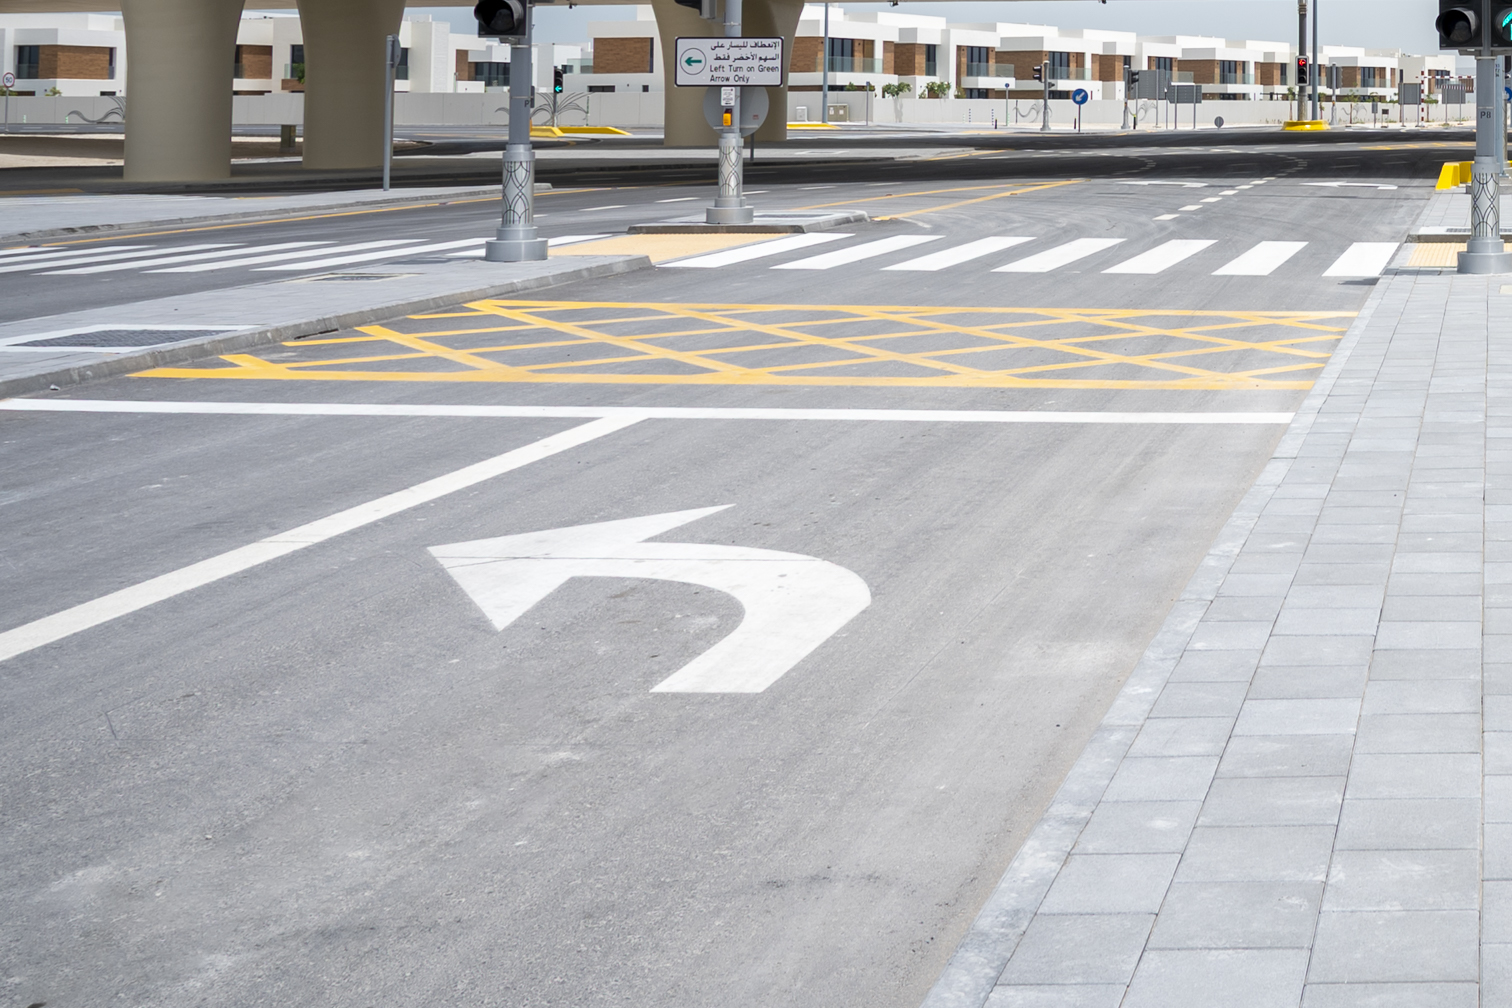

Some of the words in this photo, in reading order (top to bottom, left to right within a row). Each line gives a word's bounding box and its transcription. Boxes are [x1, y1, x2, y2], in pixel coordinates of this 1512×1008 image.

[710, 41, 725, 51] على
[726, 41, 748, 50] لليسار
[713, 53, 730, 61] فقط
[732, 52, 758, 62] الأخضر
[758, 53, 780, 62] السهم
[729, 64, 743, 72] Turn
[758, 64, 779, 72] Green
[710, 74, 730, 82] Arrow
[733, 74, 750, 83] Only
[1480, 111, 1491, 119] P8
